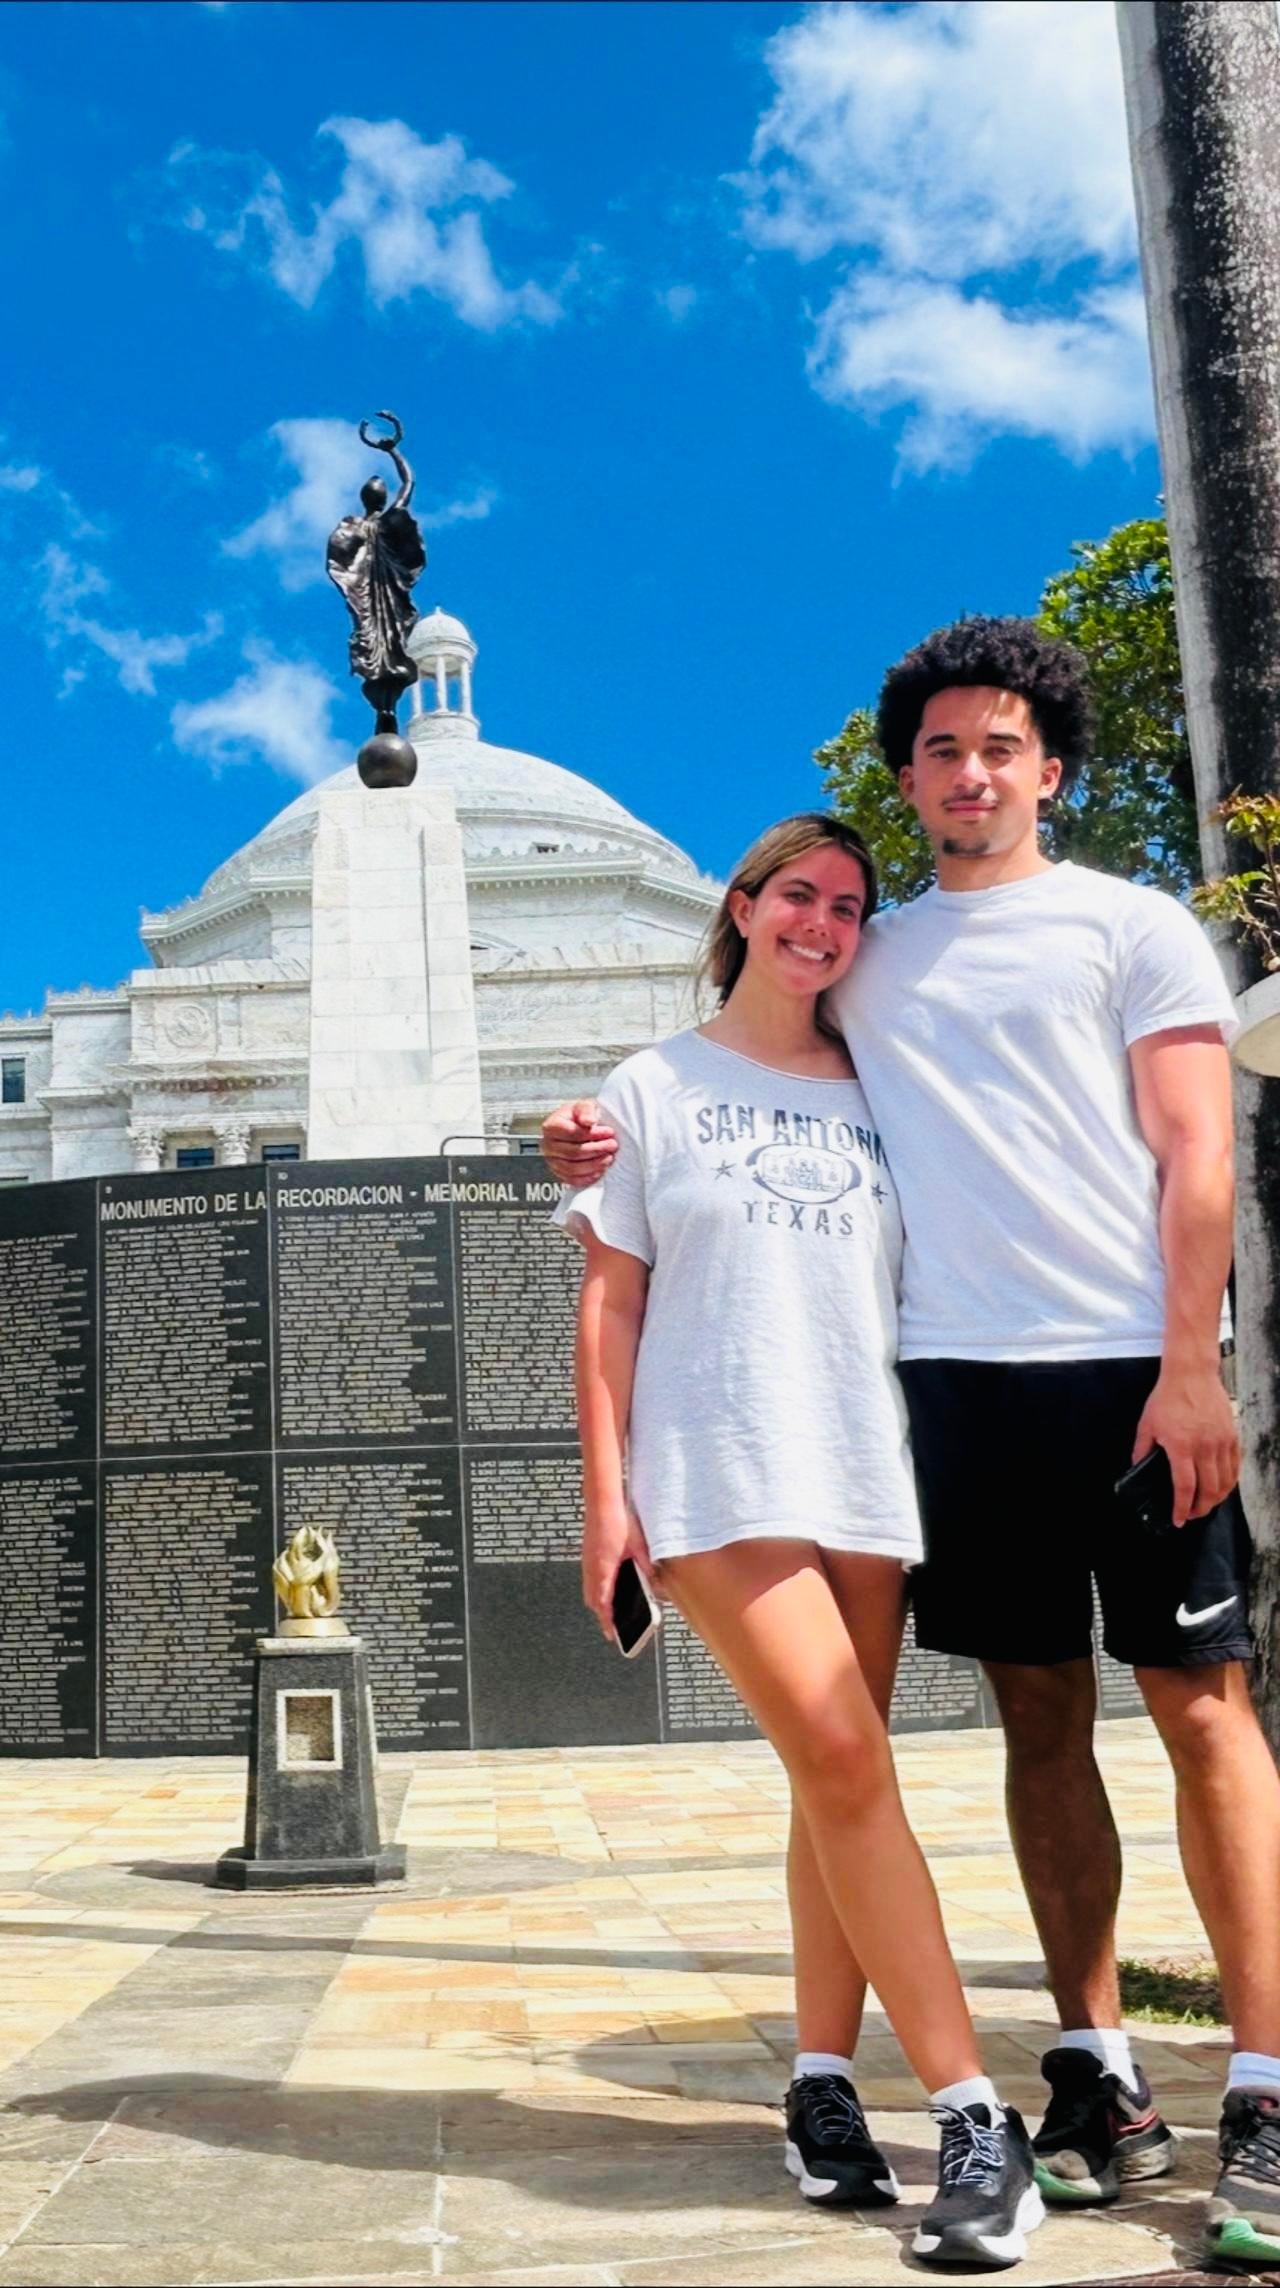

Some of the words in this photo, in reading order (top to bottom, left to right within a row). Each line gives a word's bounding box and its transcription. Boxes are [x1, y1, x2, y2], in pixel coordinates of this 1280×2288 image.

[696, 1104, 756, 1145] SAN
[773, 1109, 888, 1168] ANTONI
[101, 1196, 208, 1221] MONUMENTO
[214, 1193, 238, 1213] DE
[244, 1191, 266, 1211] LA
[277, 1185, 403, 1208] RECORDACION
[424, 1182, 519, 1203] MEMORIAL
[742, 1200, 854, 1236] TEXAS
